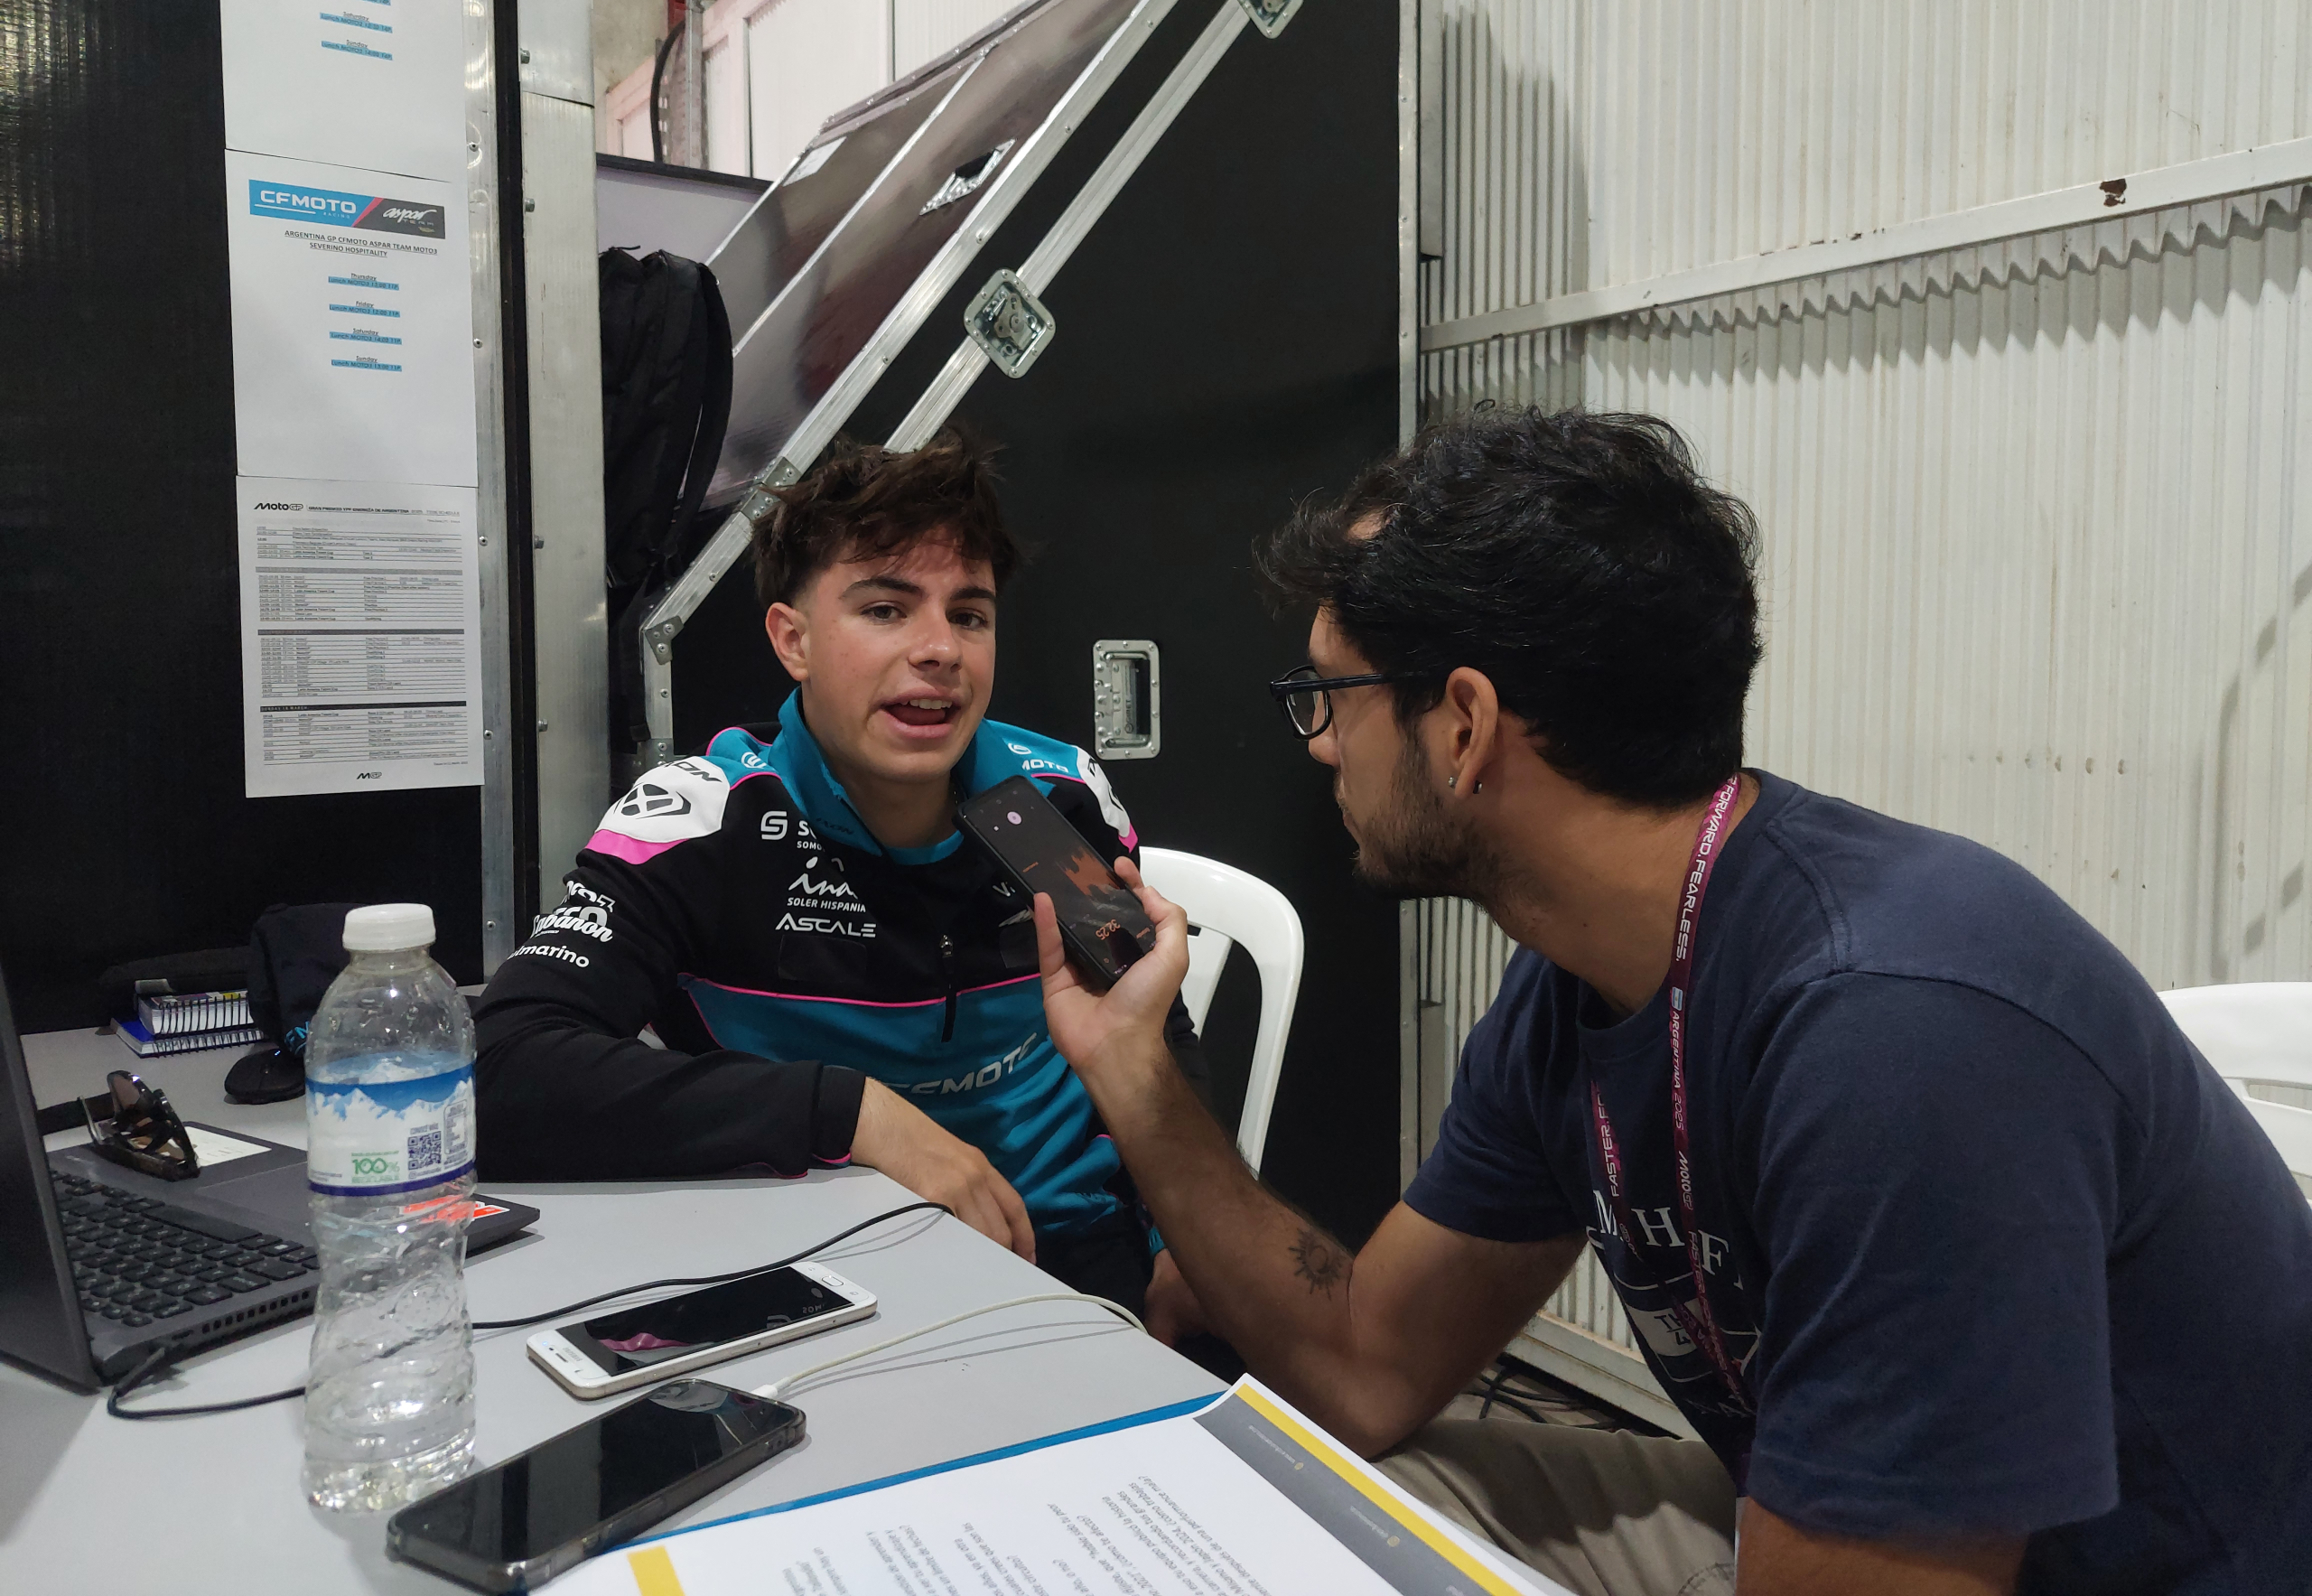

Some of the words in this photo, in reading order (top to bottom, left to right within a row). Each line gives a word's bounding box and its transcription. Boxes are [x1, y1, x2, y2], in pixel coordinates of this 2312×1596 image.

[346, 39, 368, 49] Sunday
[260, 189, 357, 214] CFMOTO
[382, 207, 438, 224] aspar
[284, 229, 326, 242] ARGENTINA
[338, 237, 368, 246] CFMOTO
[369, 240, 391, 249] ASPAR
[393, 243, 413, 252] TEAM
[413, 245, 438, 255] MOTO3
[309, 242, 344, 252] SEVERINO
[345, 247, 388, 257] HOSPITALITY
[350, 273, 378, 281] Thursday
[355, 300, 374, 309] Friday
[352, 328, 379, 336] Saturday
[356, 355, 378, 363] Sunday
[254, 502, 303, 511] MotoGP
[787, 897, 818, 909] SOLER
[820, 900, 866, 913] HISPANIA
[775, 912, 877, 938] ASCALE
[1671, 1011, 1683, 1090] ARGENTINA
[351, 1157, 401, 1175] 100%
[1137, 1473, 1161, 1493] mala?
[1128, 1480, 1155, 1507] trabajas
[1100, 1495, 1125, 1519] historia
[1115, 1489, 1145, 1517] grandes
[1158, 1490, 1201, 1531] performance
